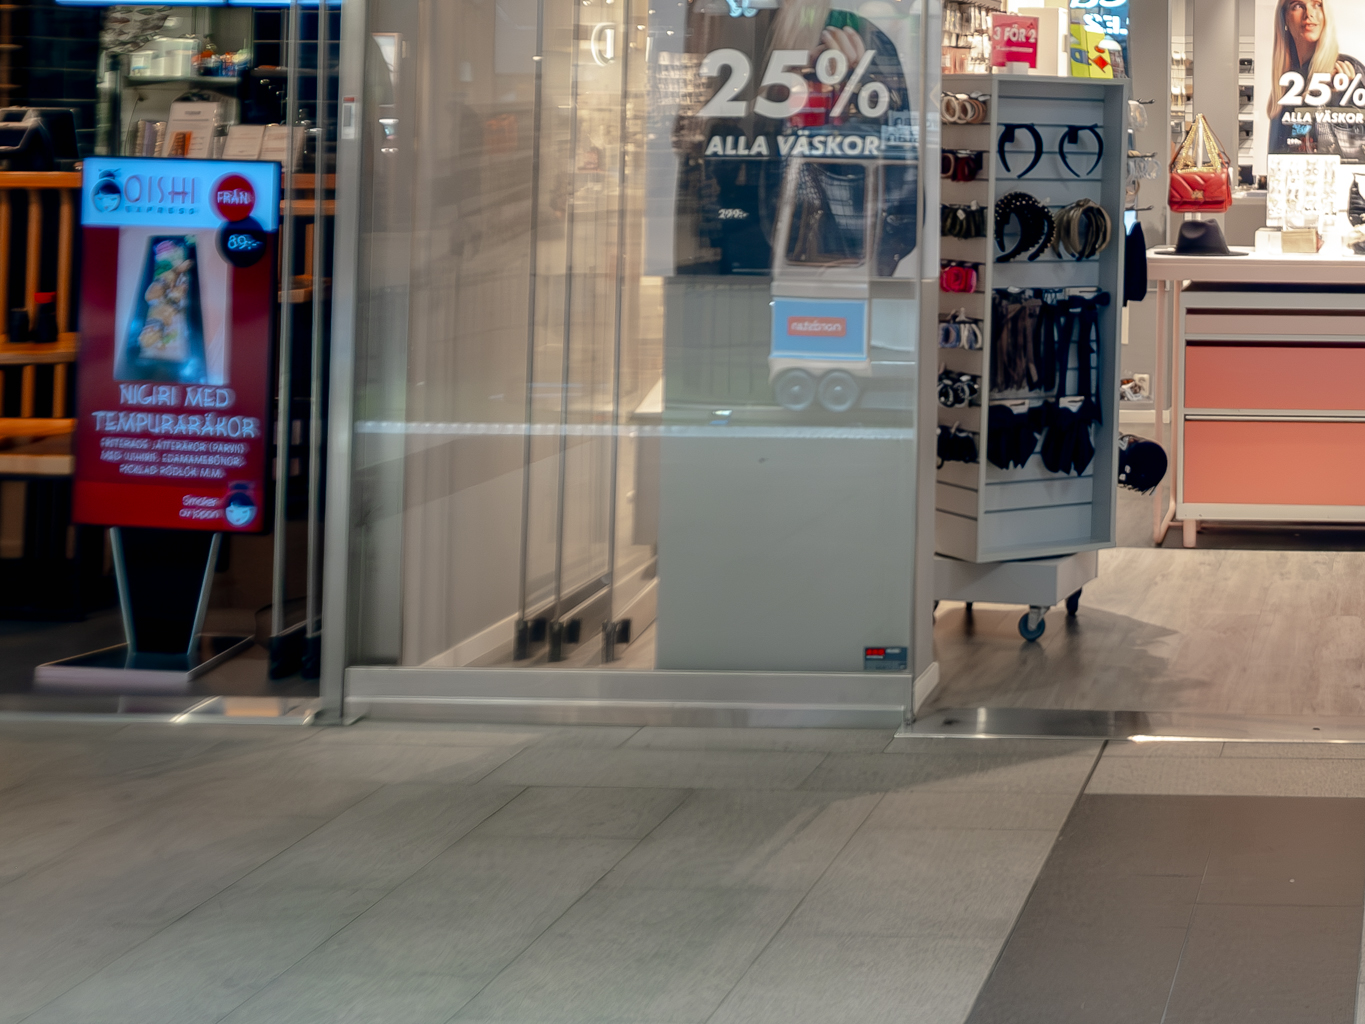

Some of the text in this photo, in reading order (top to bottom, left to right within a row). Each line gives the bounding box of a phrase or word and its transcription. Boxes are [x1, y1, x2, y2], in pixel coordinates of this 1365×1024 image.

[993, 23, 1036, 43] 3 FÖR 2
[696, 48, 890, 118] 25%
[1281, 109, 1364, 124] ALLA VÄSKOR
[705, 130, 881, 156] ALLA VÄSKOR
[124, 175, 195, 205] OISHI
[119, 383, 232, 408] NIGIRI MED
[92, 411, 259, 438] TEMPURARÄKOR
